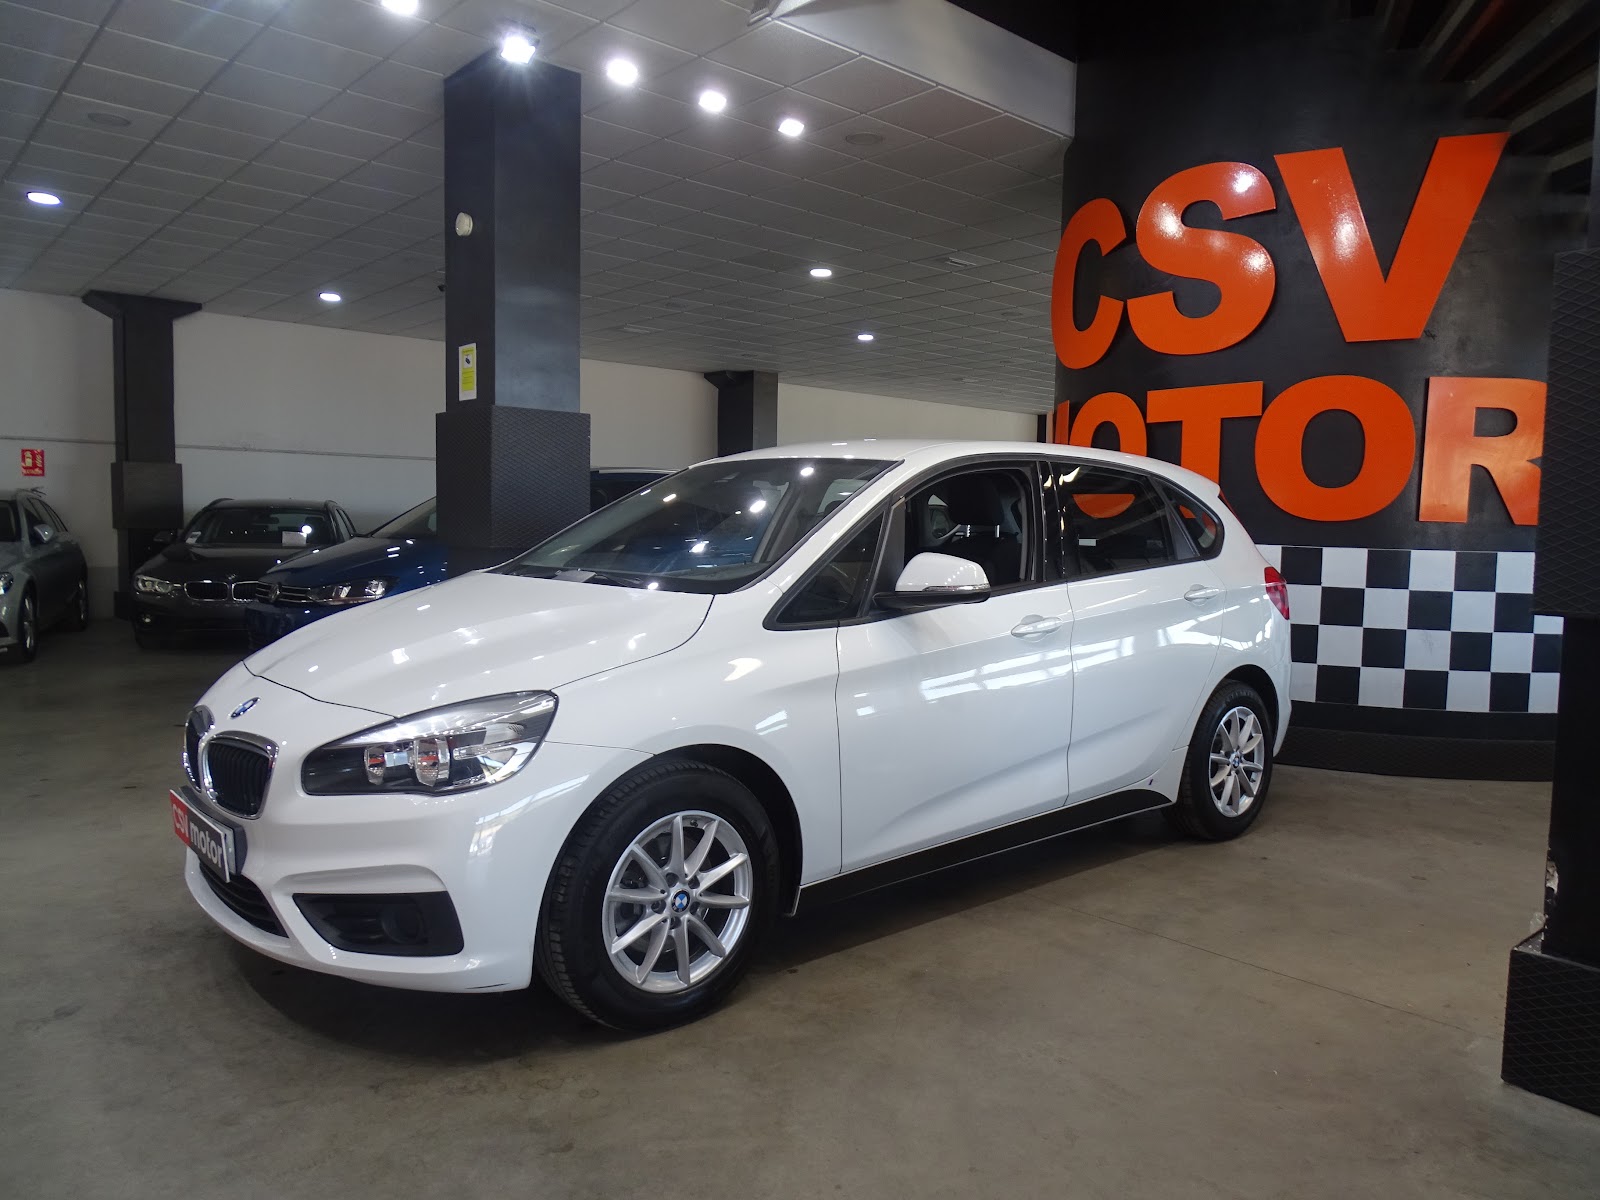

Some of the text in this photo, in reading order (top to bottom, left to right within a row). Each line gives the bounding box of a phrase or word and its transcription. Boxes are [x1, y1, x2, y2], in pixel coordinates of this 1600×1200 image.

[1051, 132, 1510, 369] CSV
[172, 803, 223, 868] CSV motor
